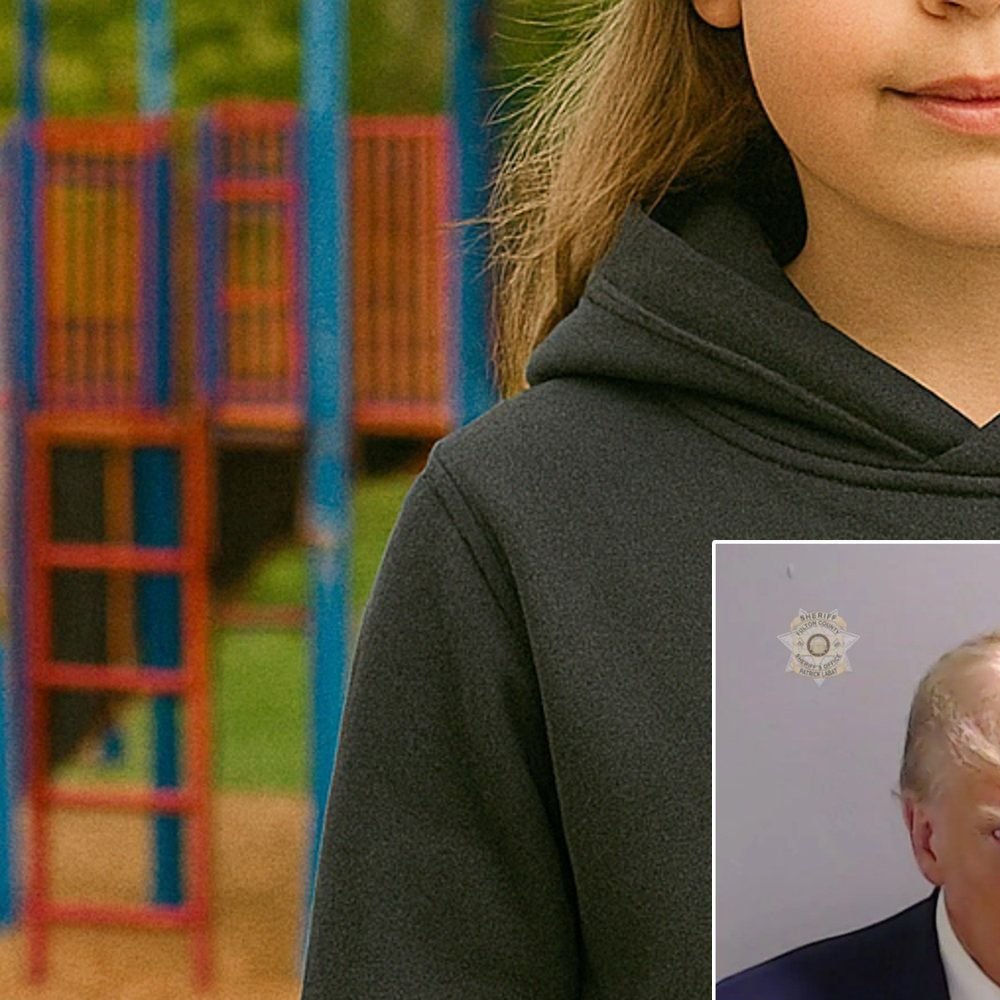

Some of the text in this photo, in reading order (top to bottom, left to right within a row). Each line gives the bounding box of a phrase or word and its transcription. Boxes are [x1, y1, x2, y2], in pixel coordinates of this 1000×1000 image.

[800, 612, 837, 621] SHERIFF
[796, 620, 840, 636] FULTON COUNTY
